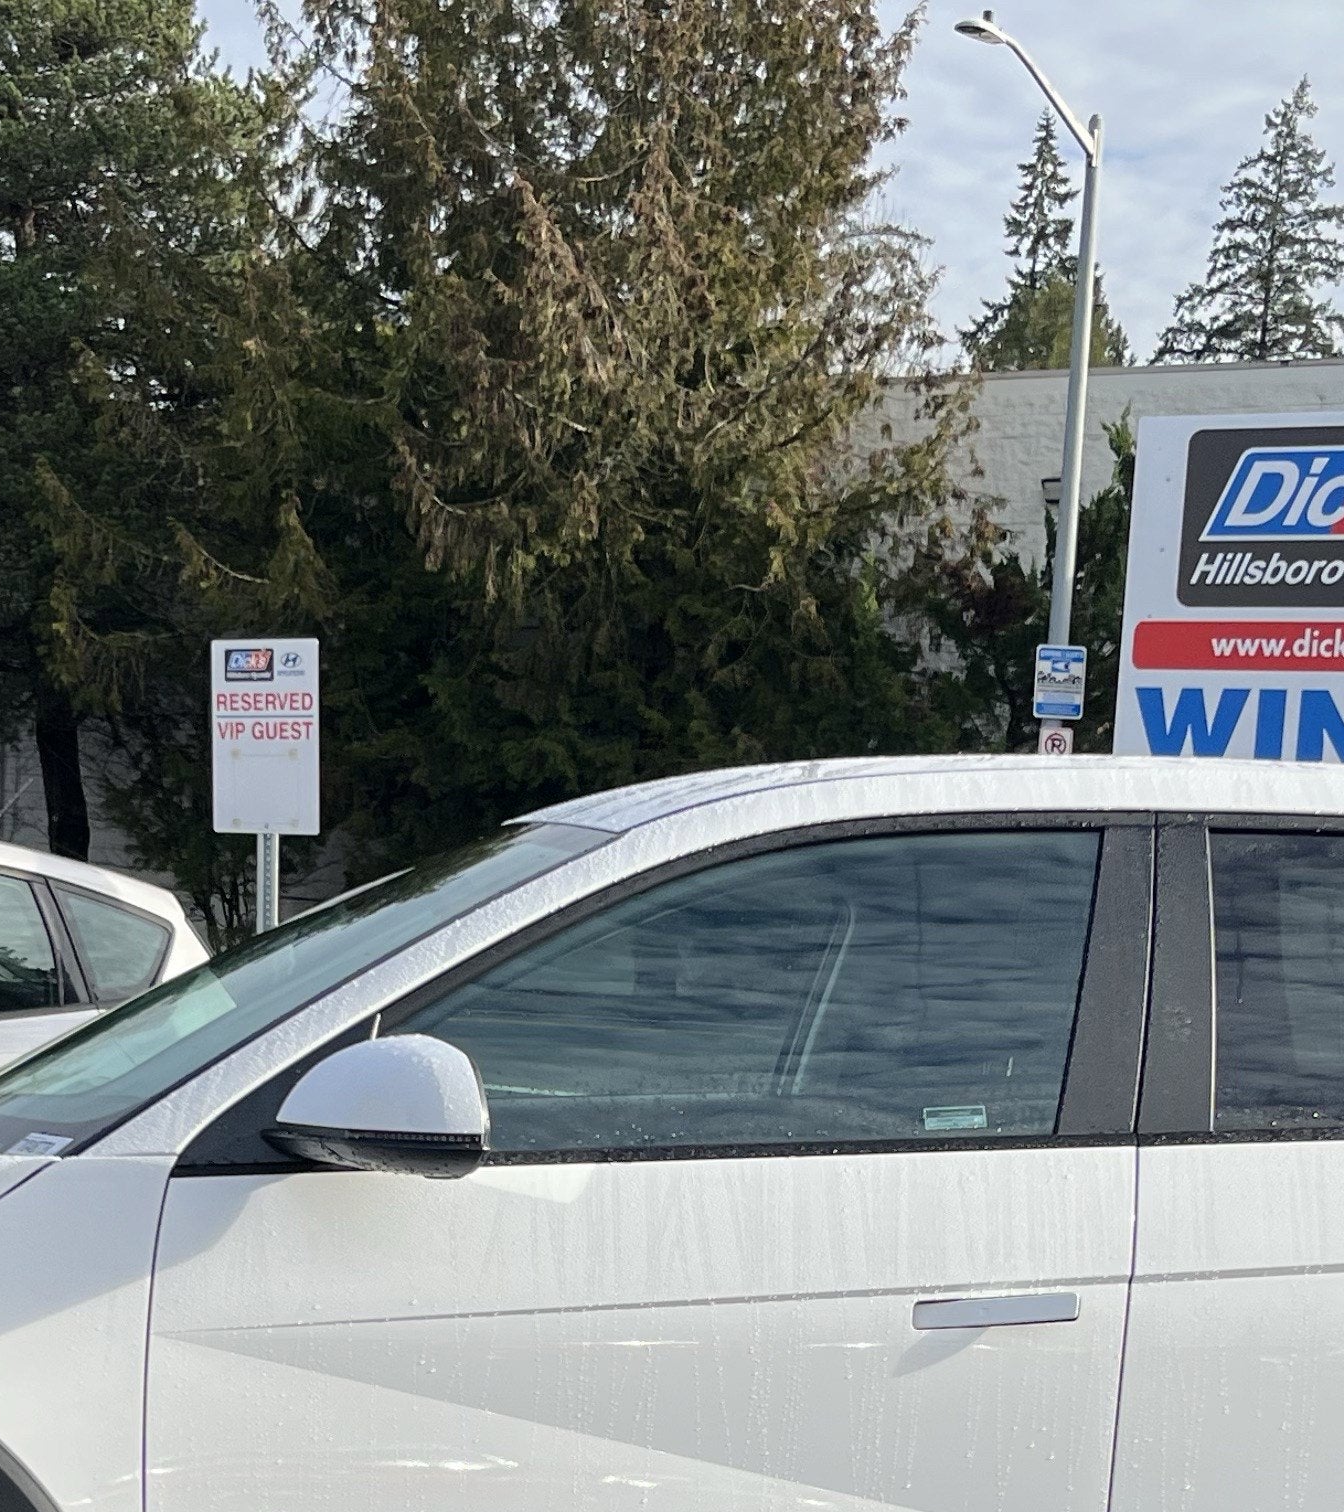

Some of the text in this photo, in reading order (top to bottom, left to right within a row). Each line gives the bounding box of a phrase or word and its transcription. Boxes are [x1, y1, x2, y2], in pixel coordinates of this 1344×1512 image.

[216, 693, 314, 711] RESERVED
[217, 722, 314, 740] VIP GUEST
